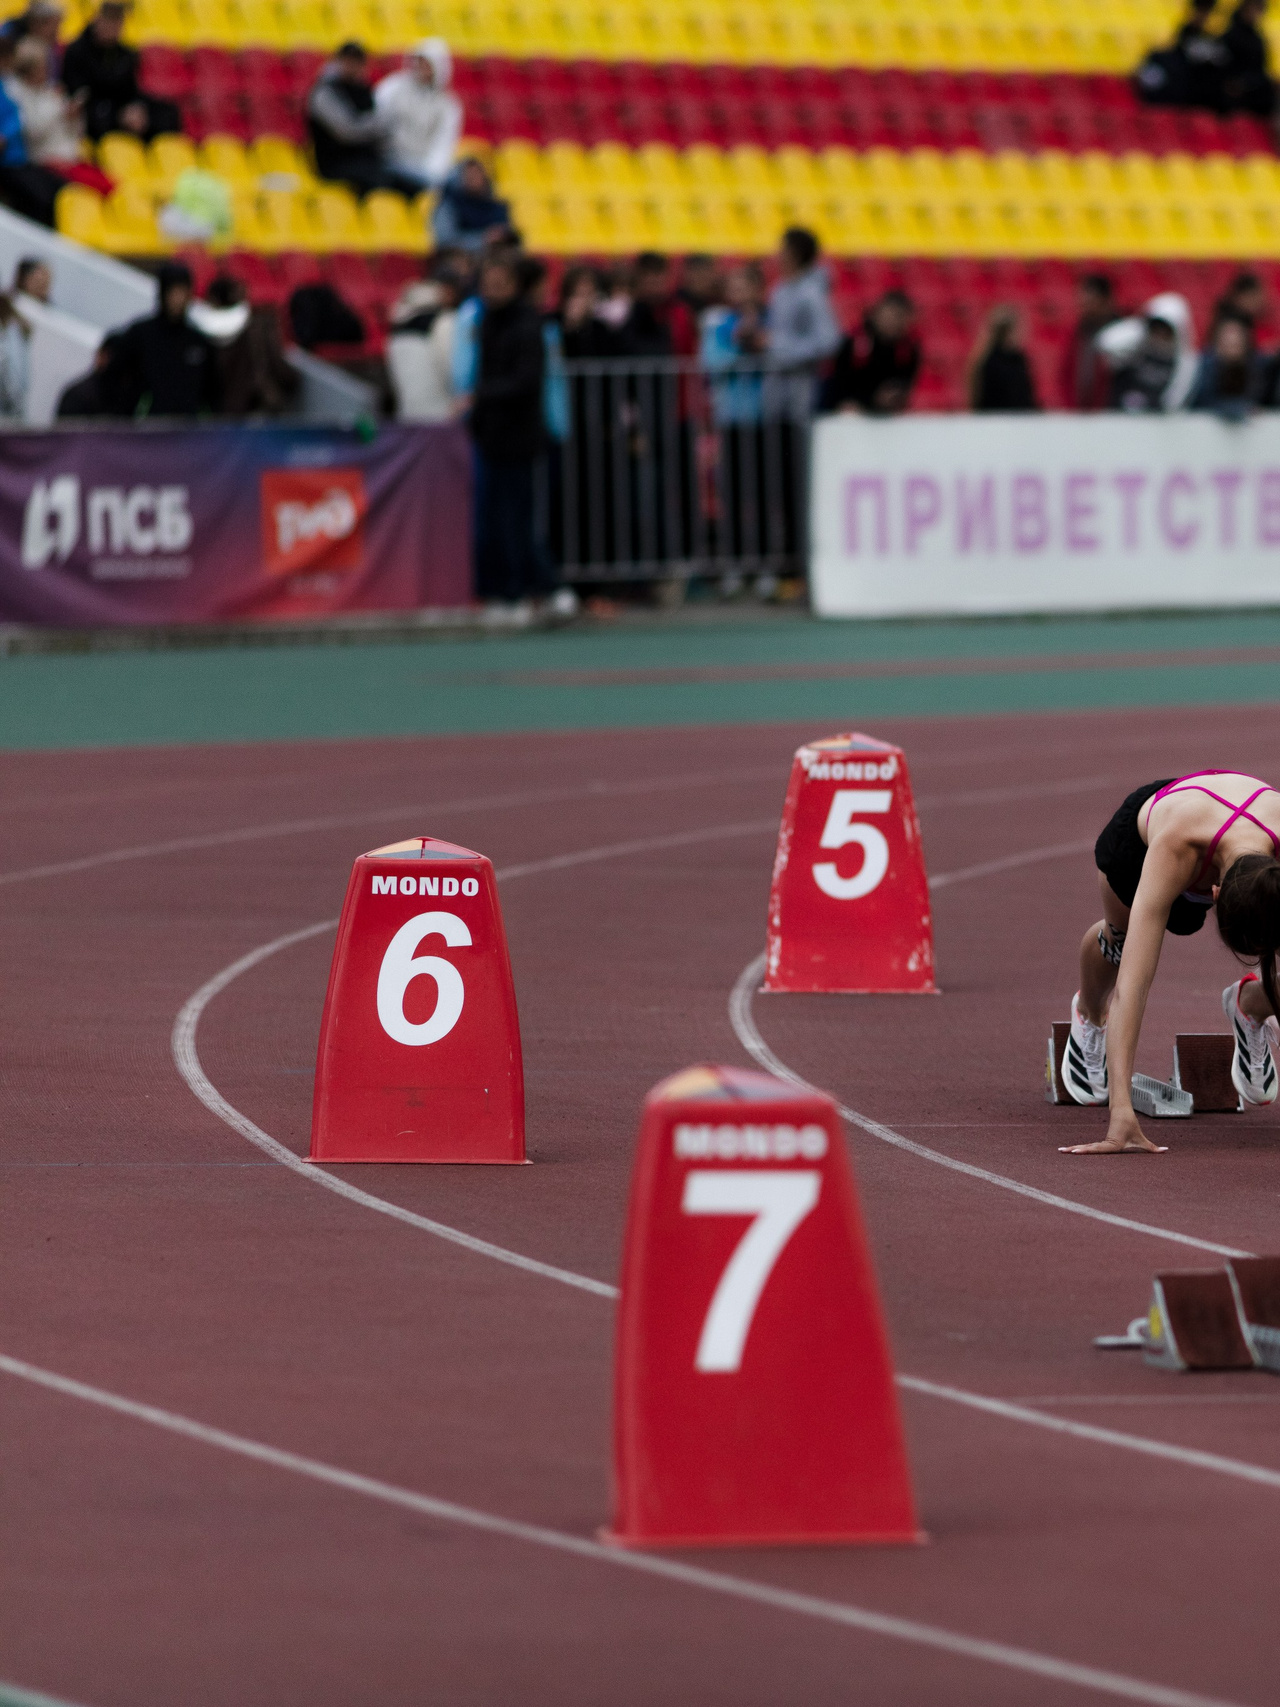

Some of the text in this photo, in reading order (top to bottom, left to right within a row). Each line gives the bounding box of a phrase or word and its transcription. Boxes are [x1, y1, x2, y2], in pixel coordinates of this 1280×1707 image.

[87, 484, 194, 554] ПСБ
[808, 761, 896, 781] MONDO
[812, 789, 893, 900] 5
[371, 875, 480, 897] MONDO
[376, 910, 473, 1047] 6
[673, 1123, 829, 1160] MONDO
[681, 1169, 822, 1375] 7
